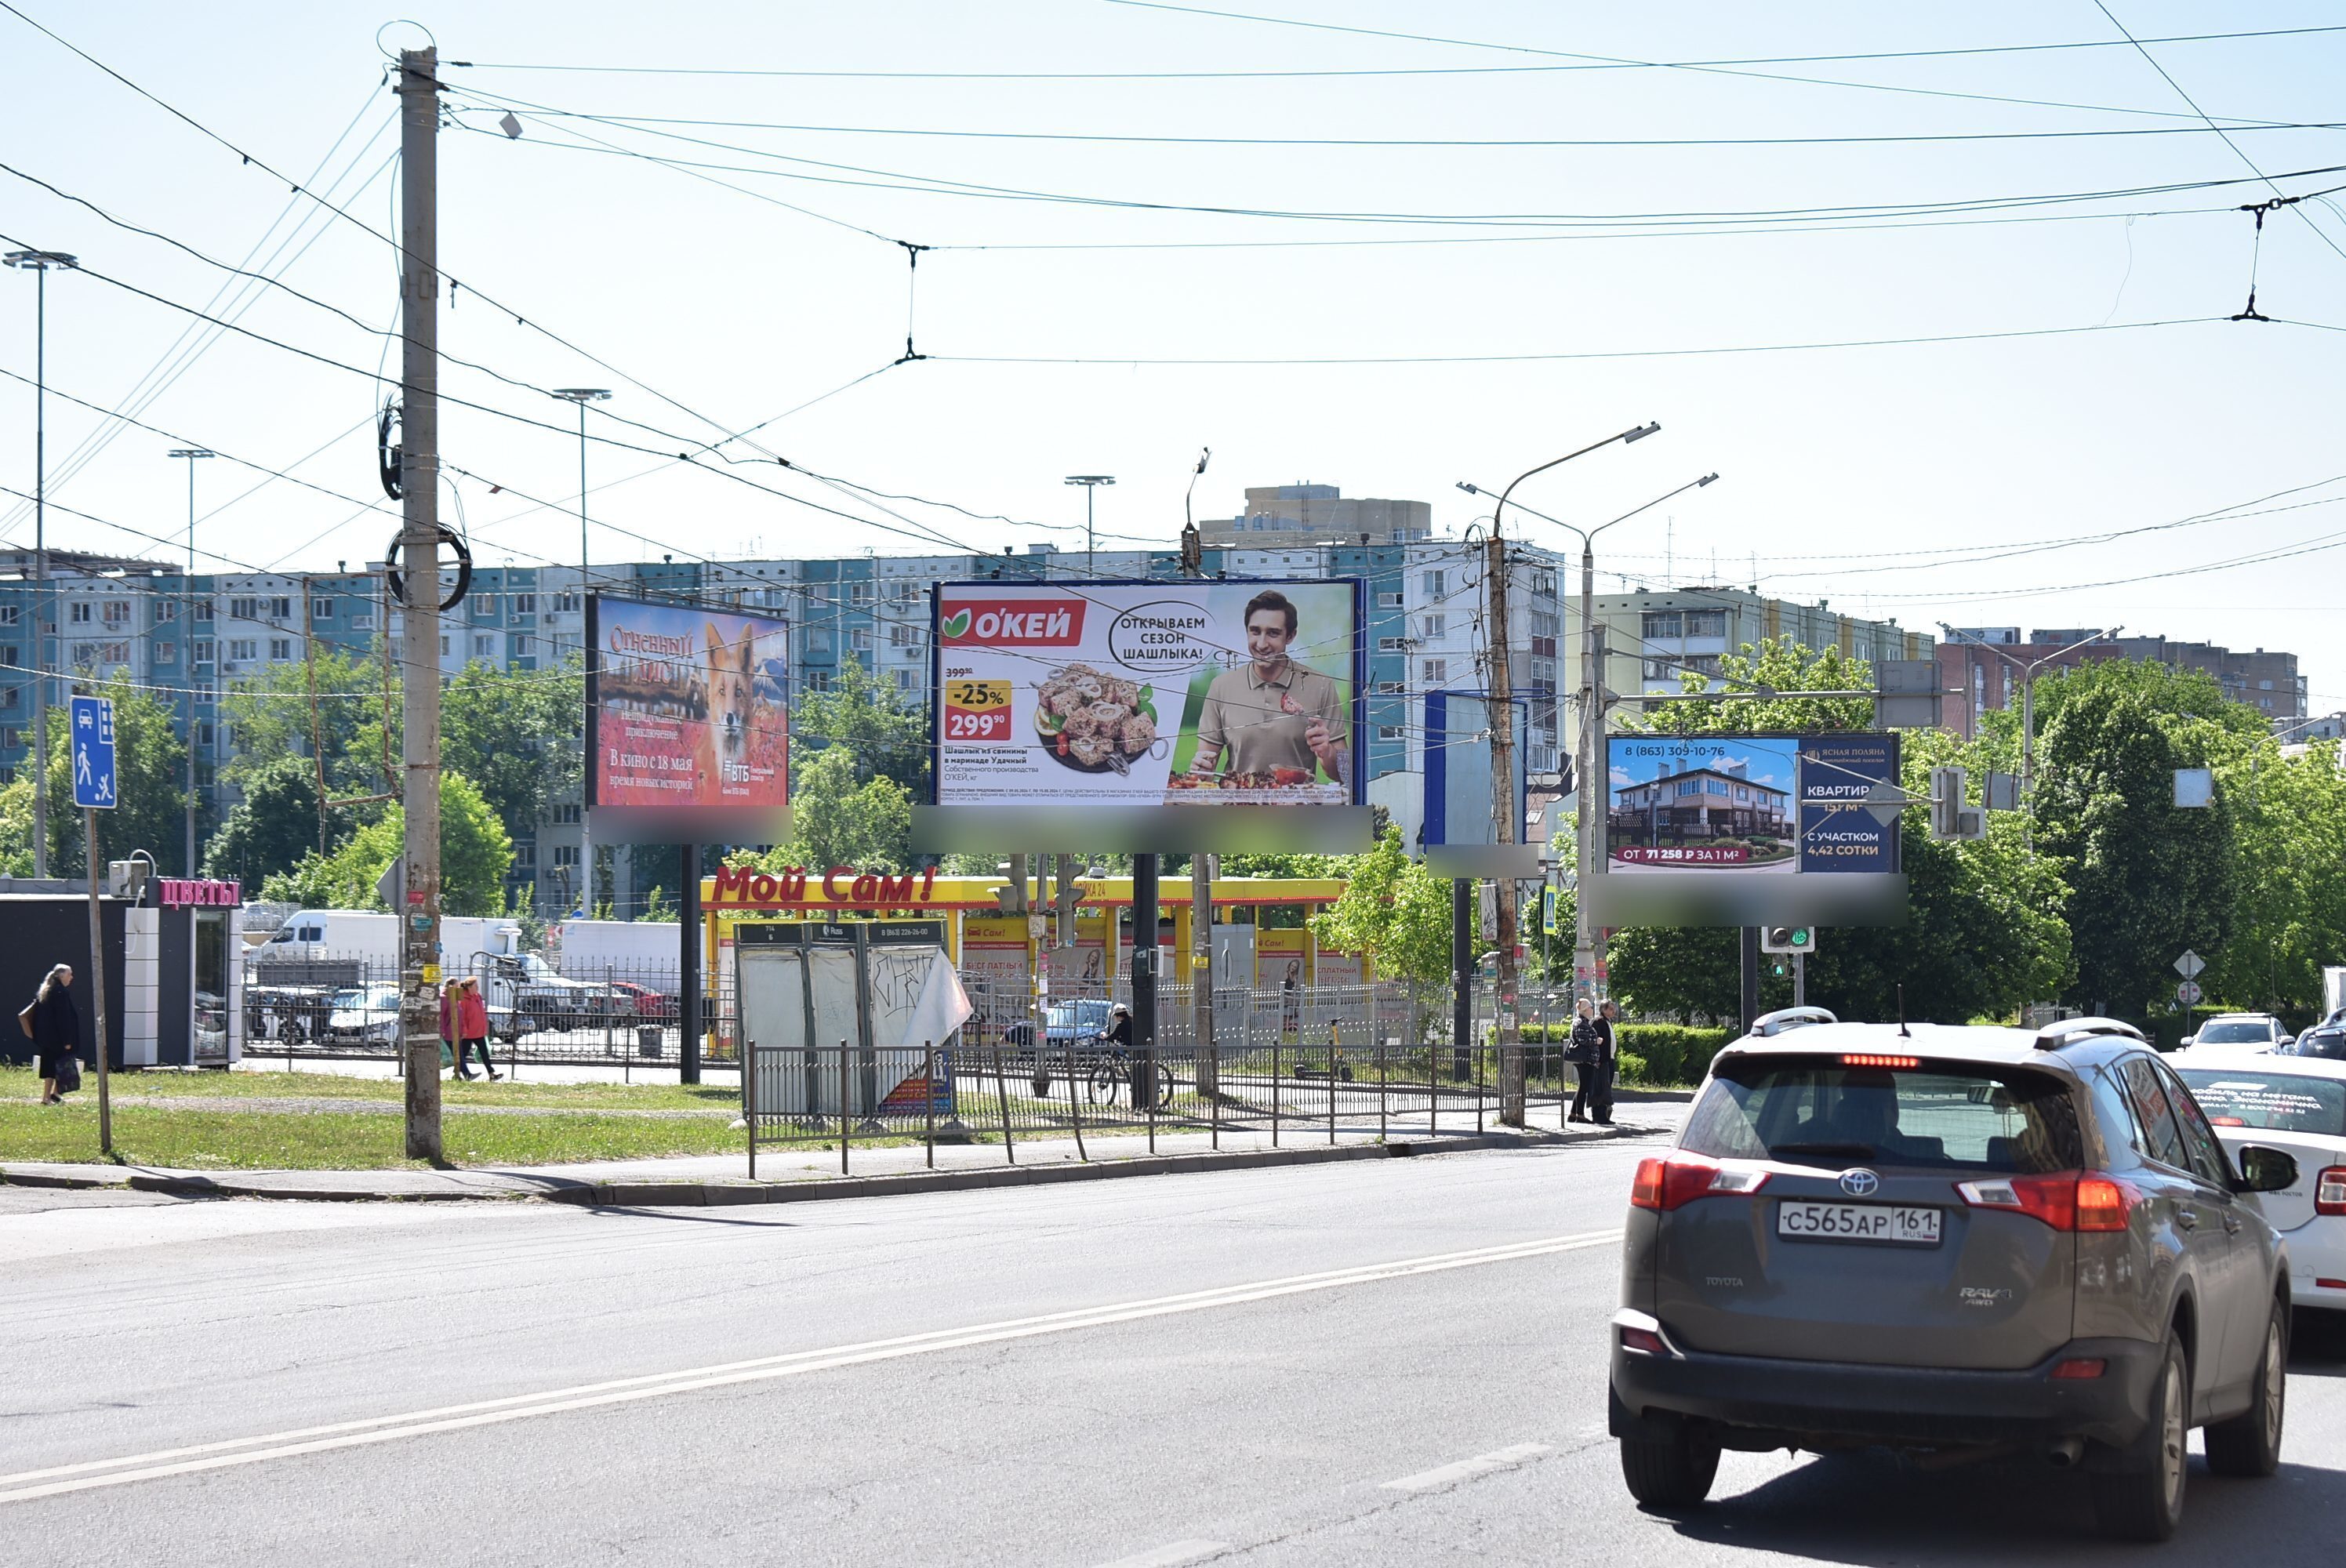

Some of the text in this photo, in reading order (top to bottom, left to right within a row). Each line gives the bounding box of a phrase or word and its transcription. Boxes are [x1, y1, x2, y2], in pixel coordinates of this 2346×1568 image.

[1120, 618, 1205, 629] ОТКРЫВАЕМ
[1140, 633, 1185, 644] СЕЗОН
[1124, 648, 1203, 659] ШАШЛЫКА!
[953, 683, 1004, 705] -25%
[626, 727, 678, 740] приключение
[1625, 746, 1725, 757] 8 (863) 309-10-76
[611, 749, 693, 771] В кино с 18 мая
[732, 765, 750, 782] ВТБ
[609, 775, 693, 792] время новых историй
[1807, 786, 1875, 796] КВАРТИР
[1845, 803, 1865, 812] М
[1807, 833, 1879, 841] С УЧАСТКОМ
[1624, 850, 1640, 859] ОТ
[1647, 850, 1658, 859] 71
[1661, 850, 1683, 859] 258
[1697, 851, 1713, 860] ЗА
[1716, 851, 1720, 859] 1
[1807, 845, 1879, 856] 4,42 СОТКИ
[712, 866, 937, 902] Мой Сам!
[160, 879, 241, 910] ЦВЕТЫ
[1098, 883, 1106, 897] 24
[1896, 1210, 1934, 1231] 161
[1902, 1230, 1922, 1239] RUS
[1705, 1276, 1745, 1287] TOYOTA
[1959, 1287, 2013, 1299] RAV4
